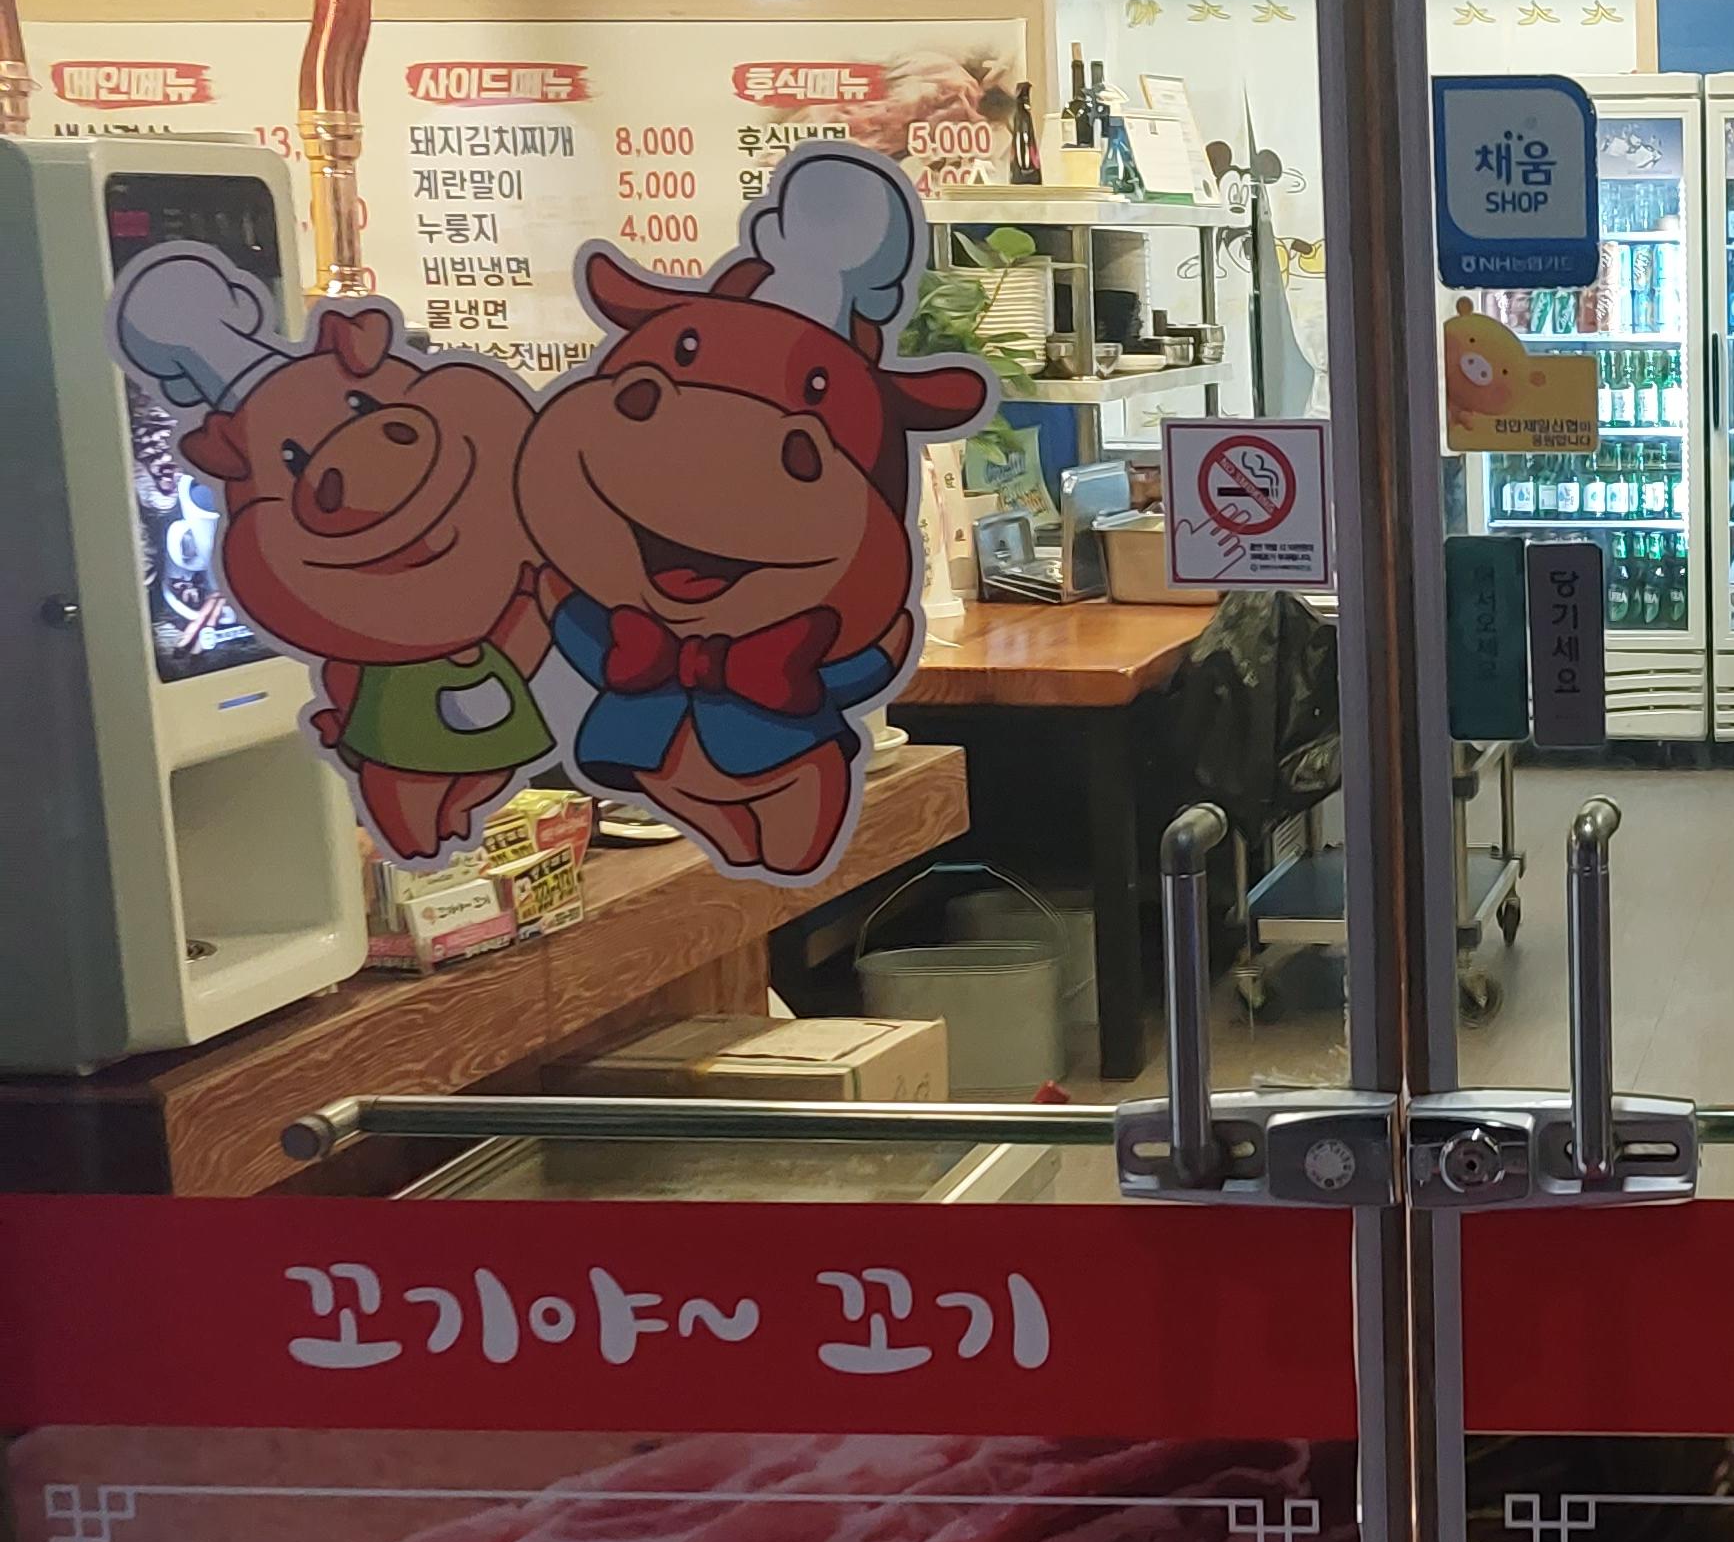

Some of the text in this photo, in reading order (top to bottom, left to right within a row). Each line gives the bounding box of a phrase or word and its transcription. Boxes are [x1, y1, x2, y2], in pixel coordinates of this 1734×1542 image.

[63, 66, 198, 102] 메인메뉴
[416, 67, 573, 100] 사이드메뉴
[744, 68, 870, 100] 후식메뉴
[410, 125, 694, 157] 돼지김치찌개 8,000
[911, 124, 991, 157] 5,000
[1475, 136, 1558, 186] 채움
[413, 169, 697, 201] 계란말이 5,000
[1485, 191, 1549, 213] SHOP
[417, 213, 699, 244] 누룽지 4,000
[423, 256, 534, 287] 비빔냉면
[427, 299, 510, 330] 물냉면
[1550, 569, 1581, 695] 당기세요
[285, 1262, 1050, 1375] 꼬기야~ 꼬기
